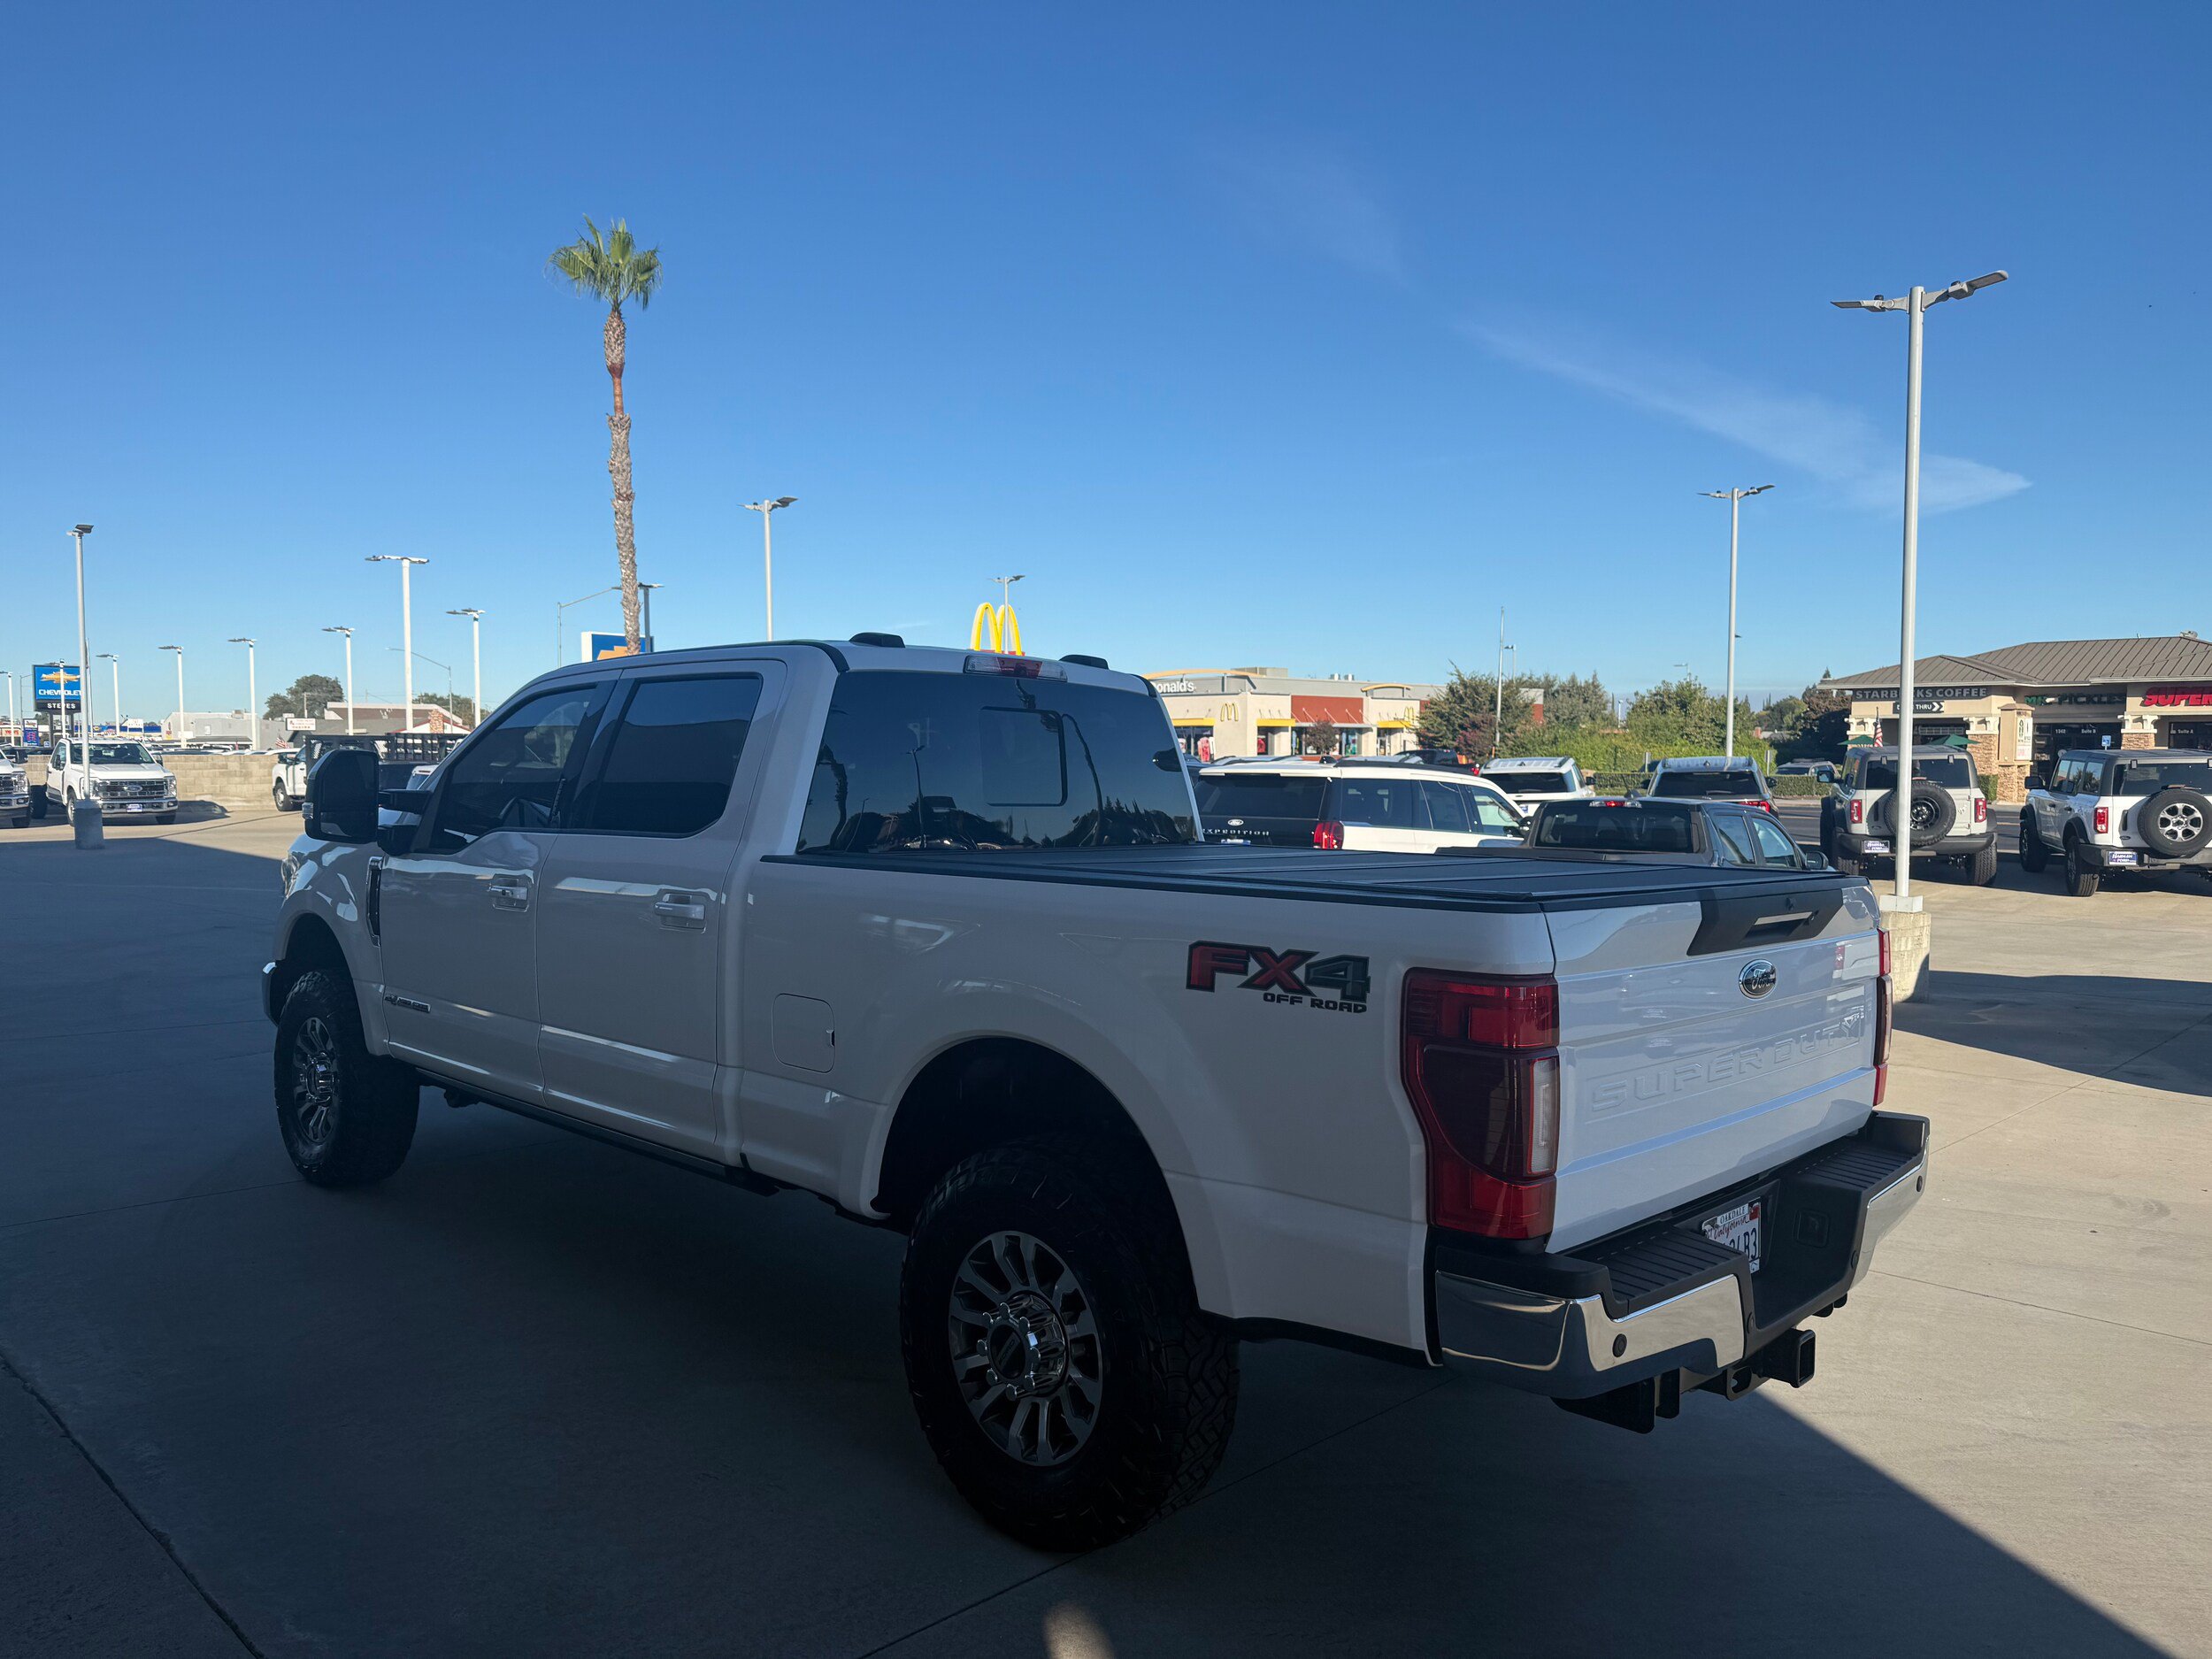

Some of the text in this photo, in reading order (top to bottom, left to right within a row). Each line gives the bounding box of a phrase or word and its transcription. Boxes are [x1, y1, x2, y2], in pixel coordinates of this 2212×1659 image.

[1855, 687, 1987, 699] STARBKS COFFEE
[1186, 941, 1371, 1003] FX4
[1263, 992, 1368, 1014] OFF ROAD
[1593, 1011, 1865, 1112] SUPER DUTY
[1719, 1205, 1746, 1225] OAKDALE
